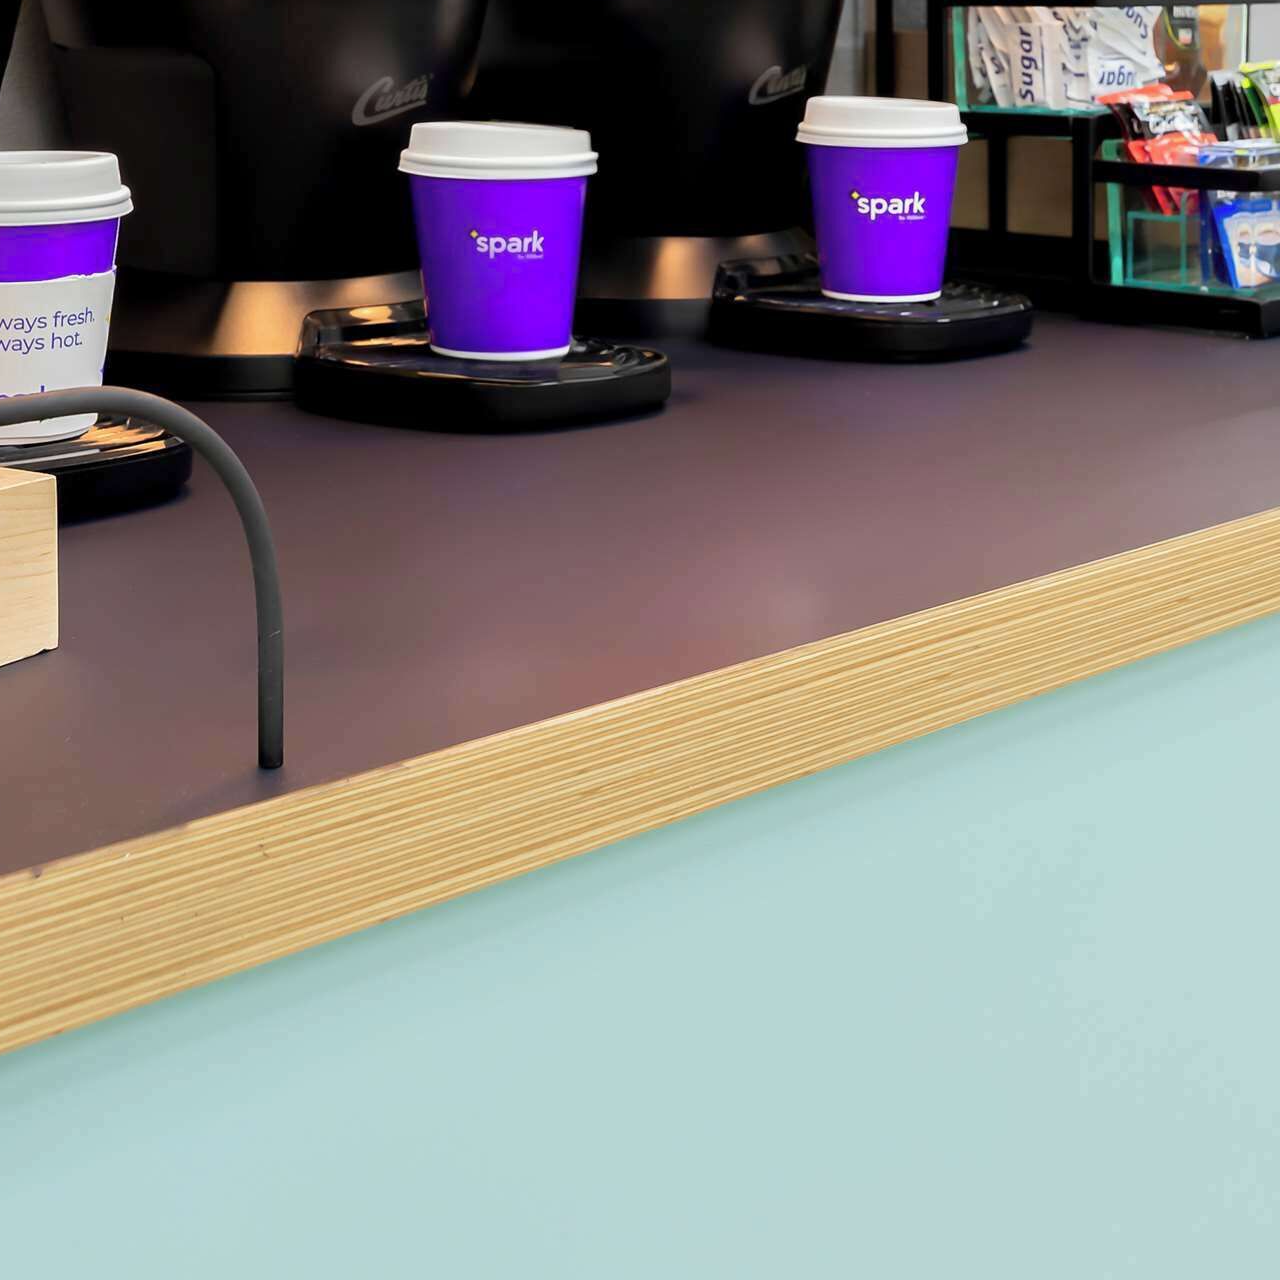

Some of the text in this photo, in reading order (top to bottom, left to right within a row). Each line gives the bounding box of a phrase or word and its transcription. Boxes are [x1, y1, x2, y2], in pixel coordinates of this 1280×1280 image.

[1019, 25, 1039, 103] Sugar
[1098, 65, 1137, 87] ugar
[352, 75, 429, 126] Curtis
[857, 191, 926, 220] spark
[476, 230, 545, 259] spark
[52, 307, 95, 328] fresh.
[51, 331, 83, 350] hot.
